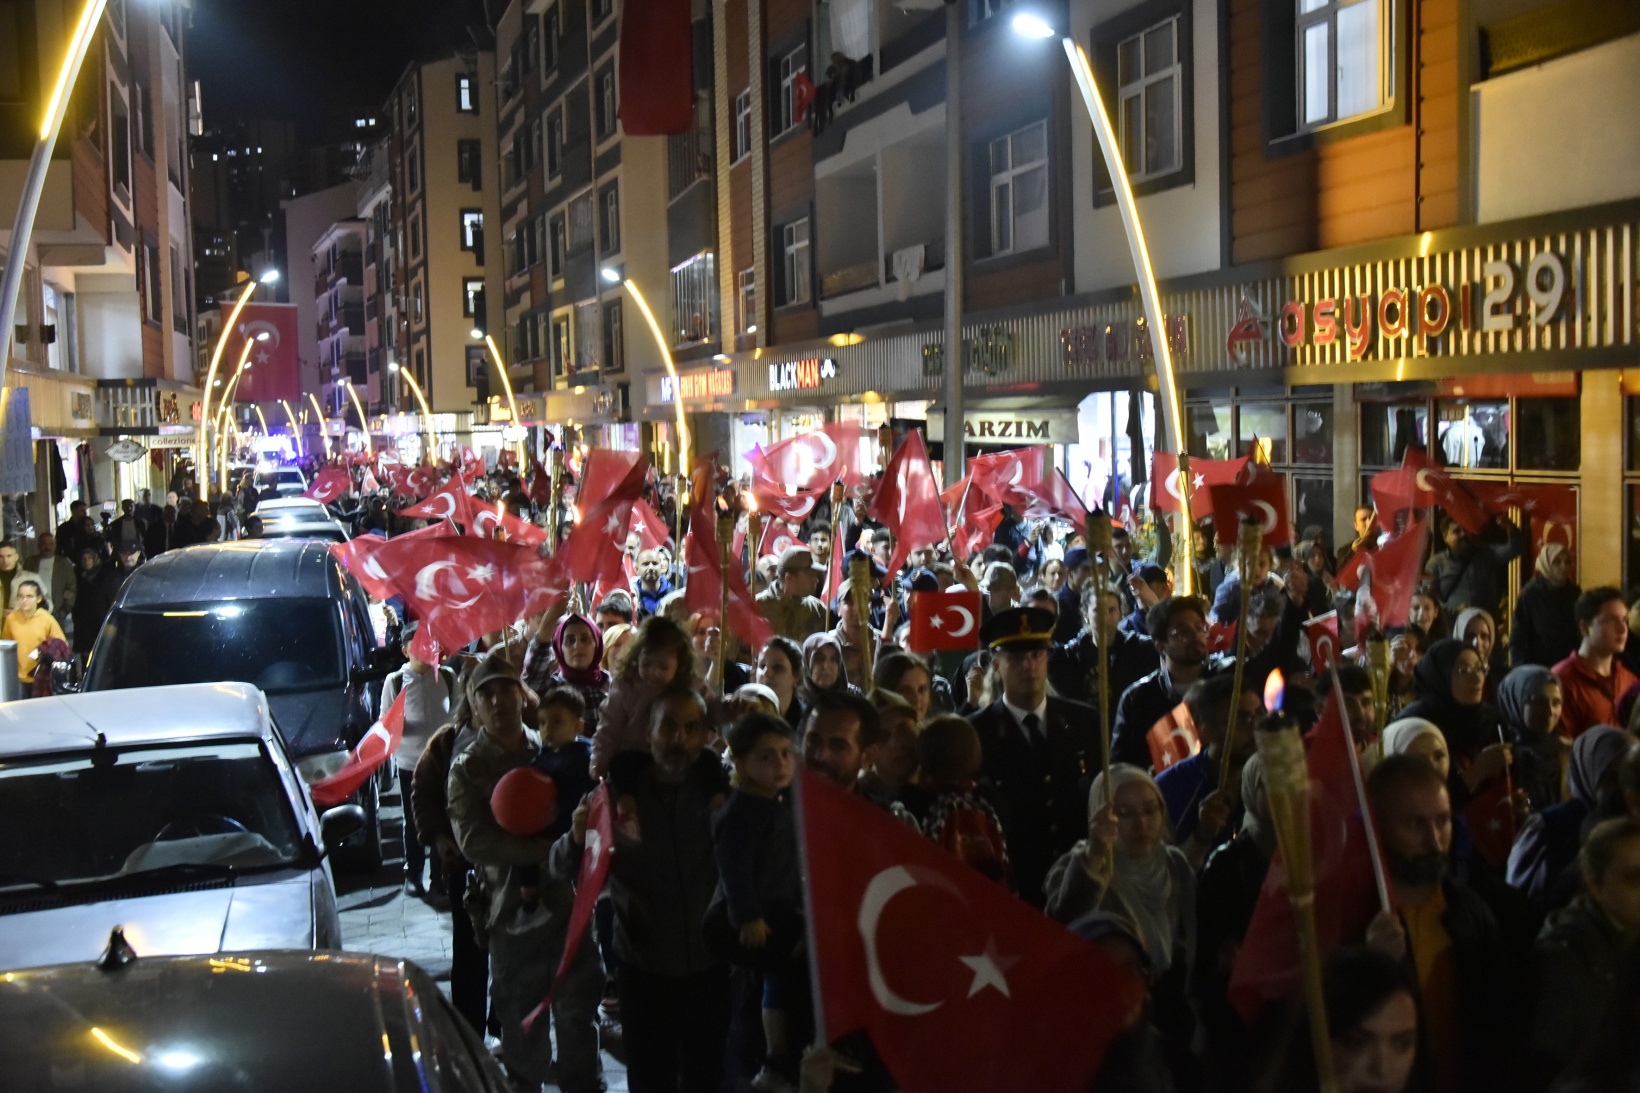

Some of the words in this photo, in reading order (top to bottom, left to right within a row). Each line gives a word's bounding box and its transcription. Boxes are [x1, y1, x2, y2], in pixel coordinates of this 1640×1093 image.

[1482, 252, 1565, 332] 29
[769, 358, 819, 392] BLACKMAN
[963, 420, 1051, 439] ARZIM
